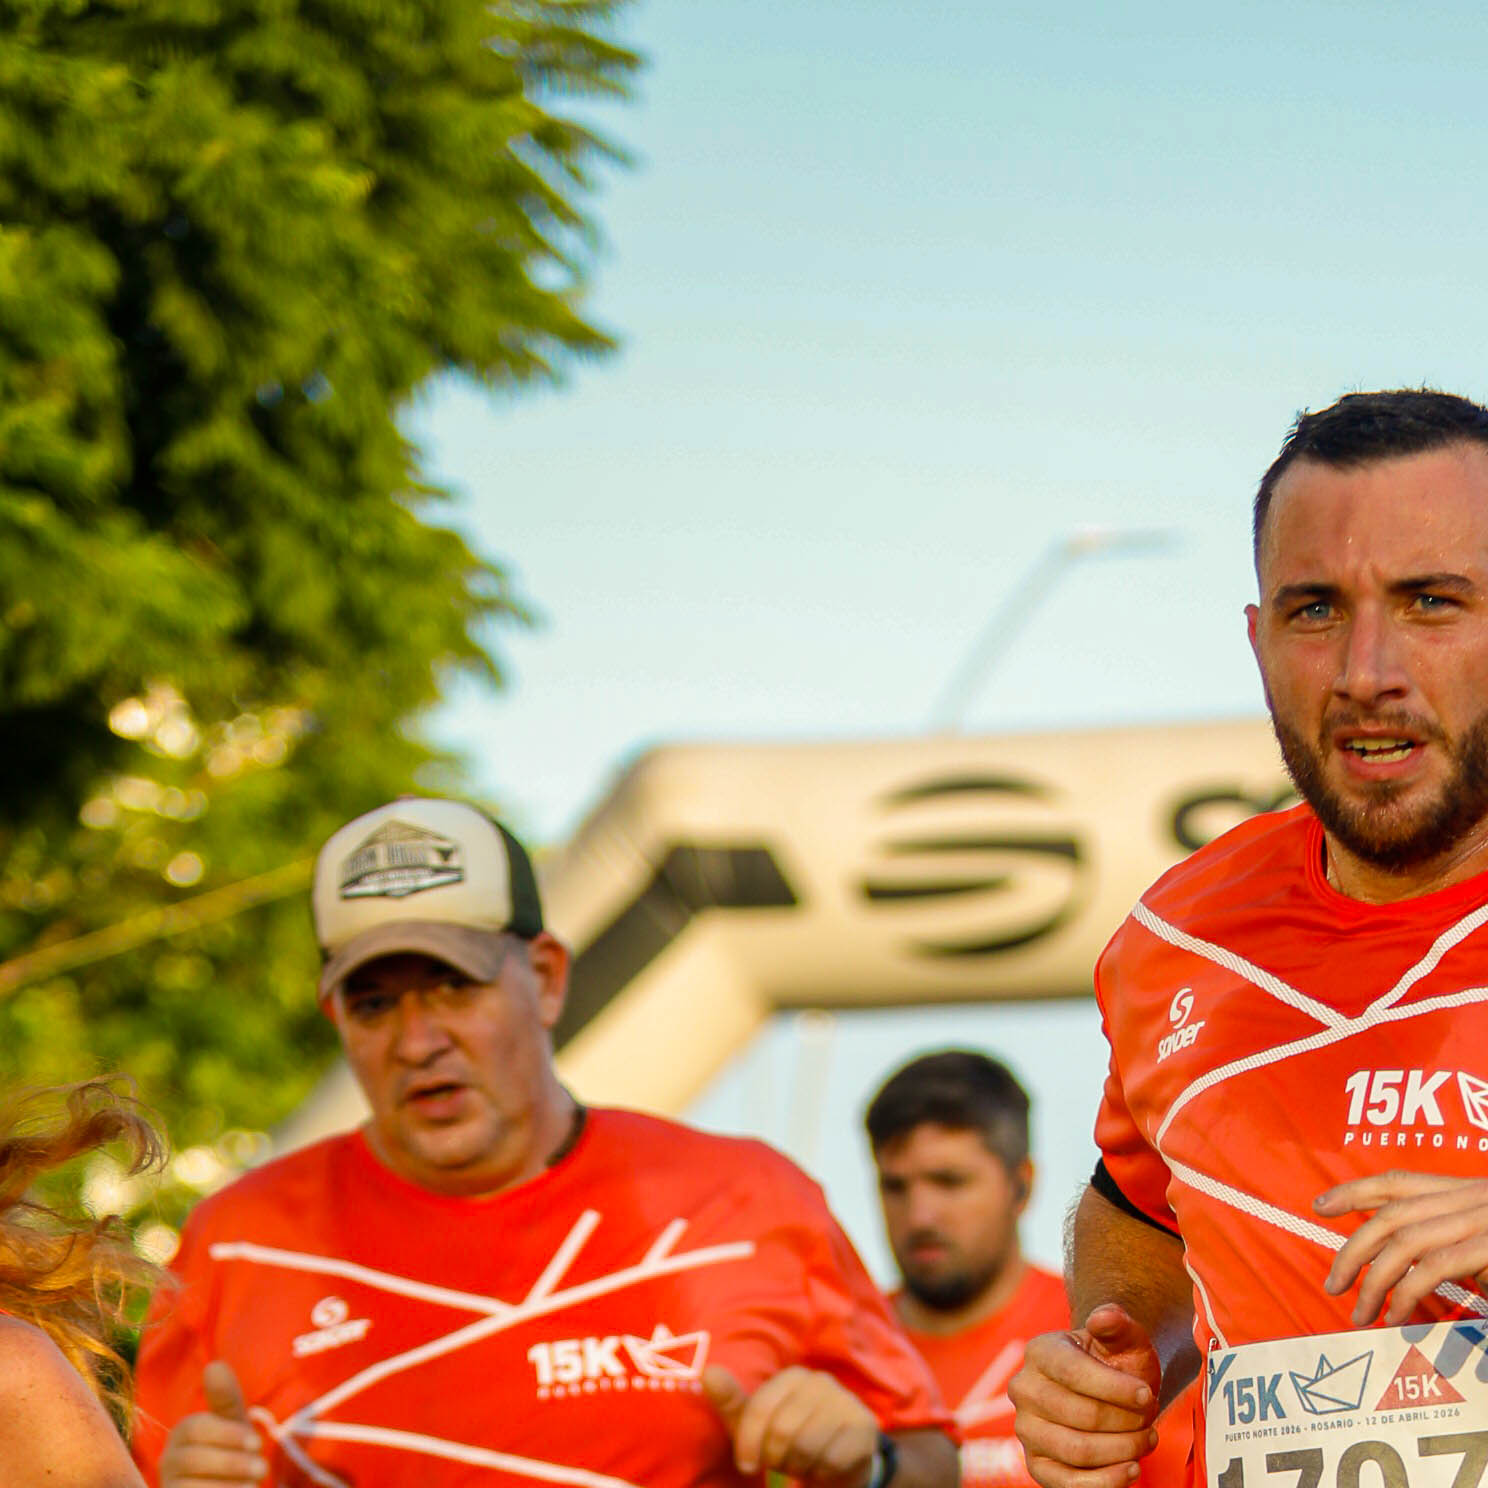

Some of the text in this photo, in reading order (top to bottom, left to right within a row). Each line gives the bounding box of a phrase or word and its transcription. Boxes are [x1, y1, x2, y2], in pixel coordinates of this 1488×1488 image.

[1344, 1070, 1452, 1126] 15K
[1344, 1131, 1444, 1148] PUERTO
[528, 1335, 626, 1385] 15K
[1223, 1373, 1287, 1426] 15K
[1393, 1372, 1445, 1401] 15K
[1225, 1431, 1251, 1443] PUERTO
[1252, 1428, 1278, 1439] NORTE
[1280, 1425, 1301, 1436] 2026
[1310, 1418, 1354, 1432] ROSARIO
[1365, 1416, 1377, 1427] 12
[1380, 1414, 1395, 1424] DE
[1398, 1411, 1429, 1423] ABRIL
[1433, 1408, 1461, 1419] 2026
